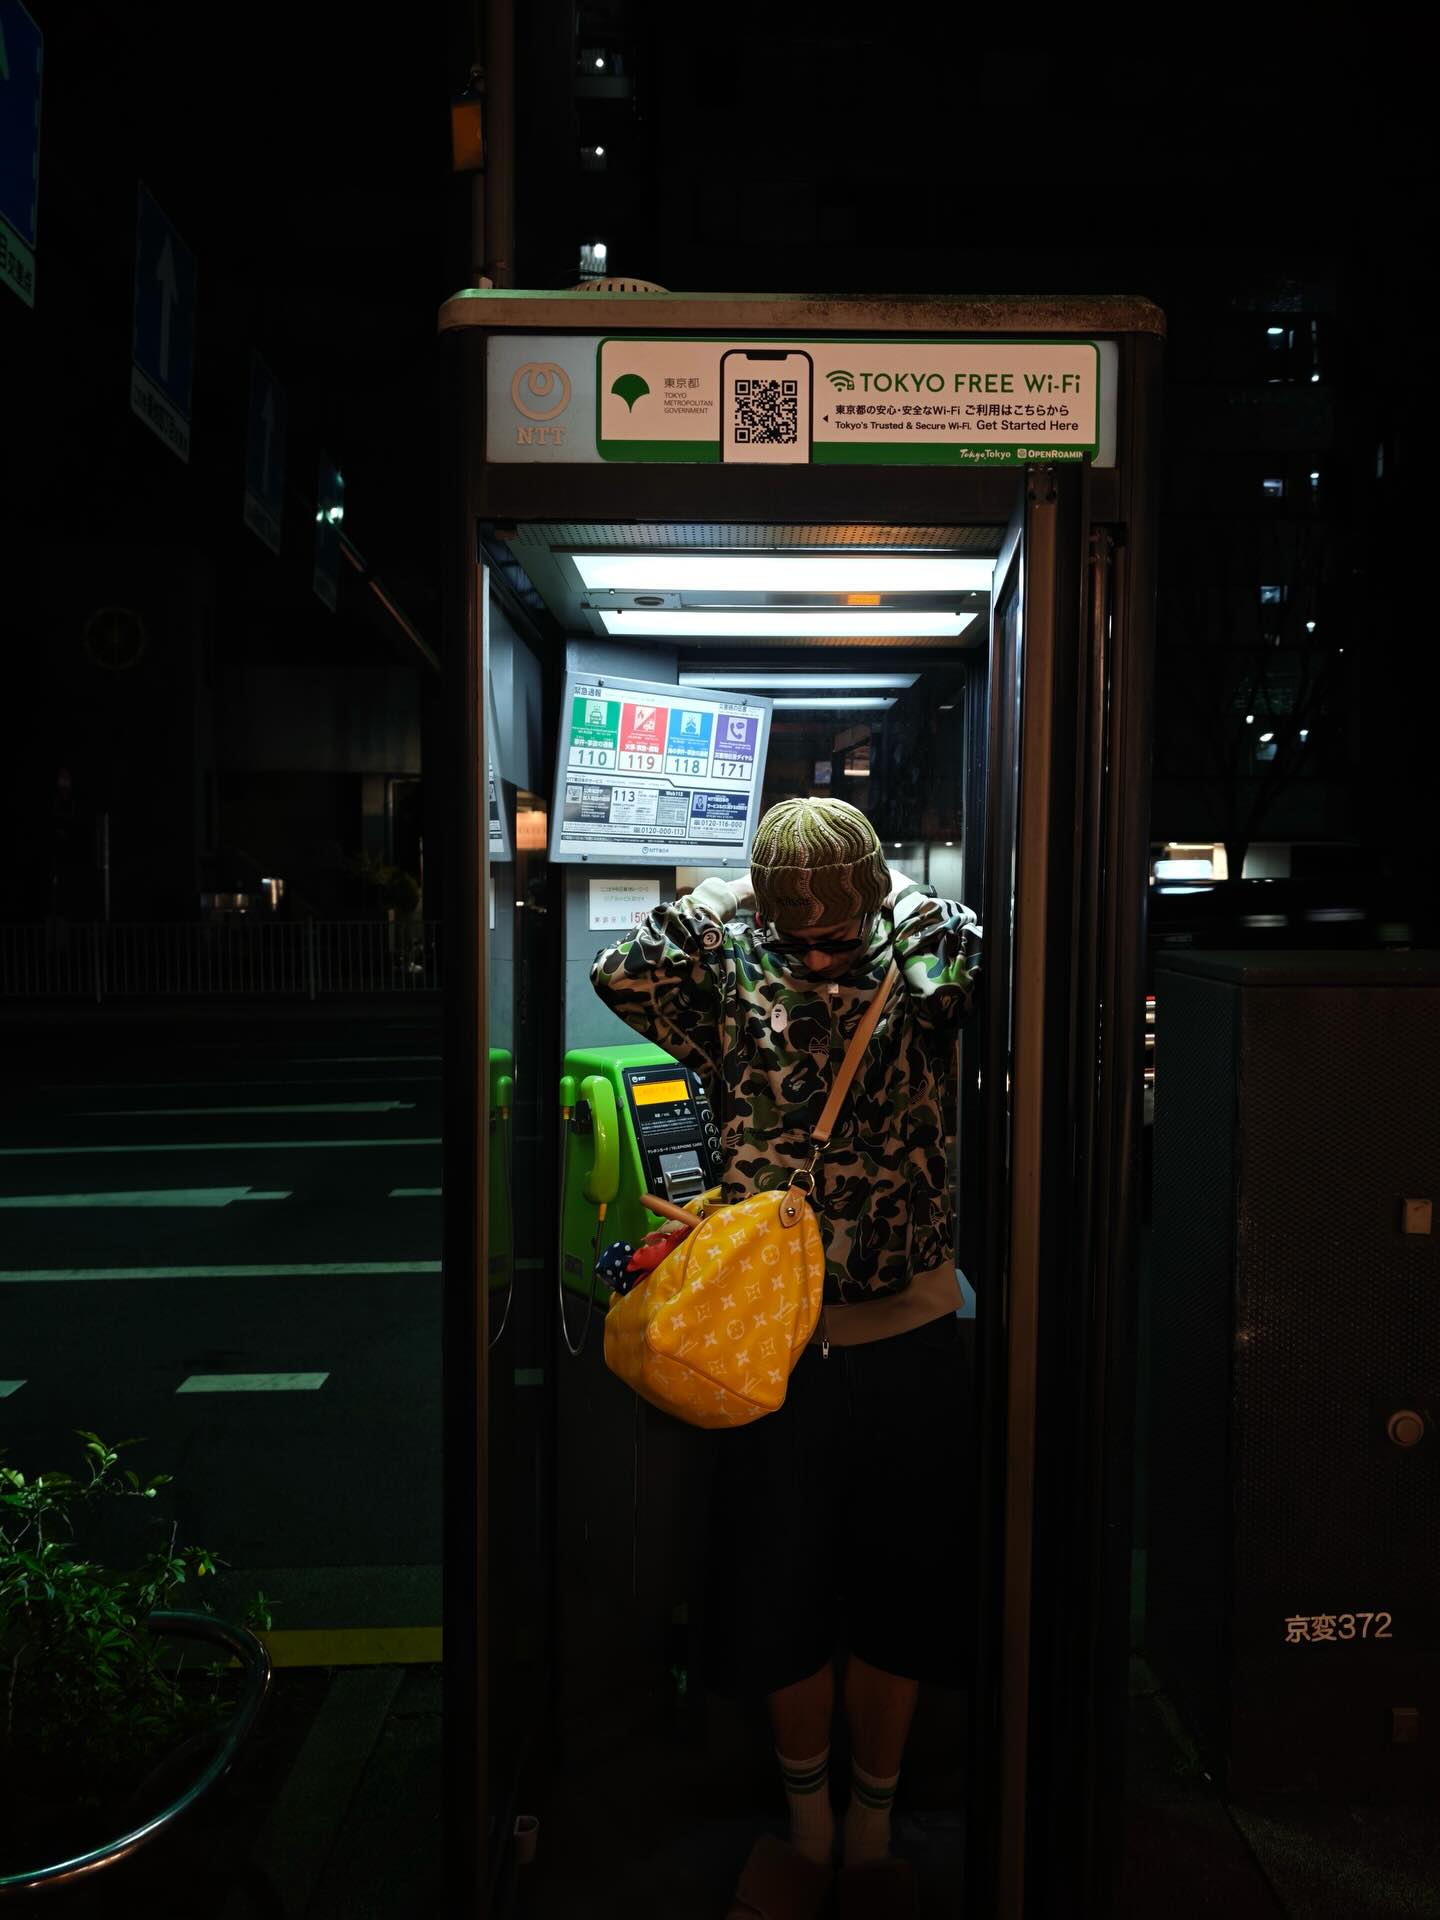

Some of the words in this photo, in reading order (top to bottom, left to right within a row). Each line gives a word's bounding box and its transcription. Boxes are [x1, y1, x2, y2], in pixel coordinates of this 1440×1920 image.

[663, 377, 701, 389] 東京都
[859, 372, 946, 393] TOKYO
[954, 373, 1015, 393] FREE
[1023, 373, 1082, 394] Wi-Fi
[663, 407, 709, 415] GOVERNMENT
[835, 404, 961, 416] 東京都の安心・安全なWi-Fi
[964, 404, 1070, 417] ご利用はこちらから
[835, 421, 868, 431] Tokyo's
[870, 421, 904, 431] Trusted
[906, 422, 913, 431] &
[915, 421, 946, 431] Secure
[976, 420, 998, 431] Get
[1001, 420, 1047, 431] Started
[1050, 420, 1079, 431] Here
[516, 427, 566, 446] NTT
[577, 749, 607, 766] 110
[628, 754, 656, 770] 119
[674, 758, 701, 774] 118
[719, 761, 745, 777] 171
[613, 790, 636, 802] 113
[701, 819, 743, 828] 0120-116-000
[640, 826, 684, 836] 0120-000-113
[1283, 1612, 1393, 1644] 京変372
